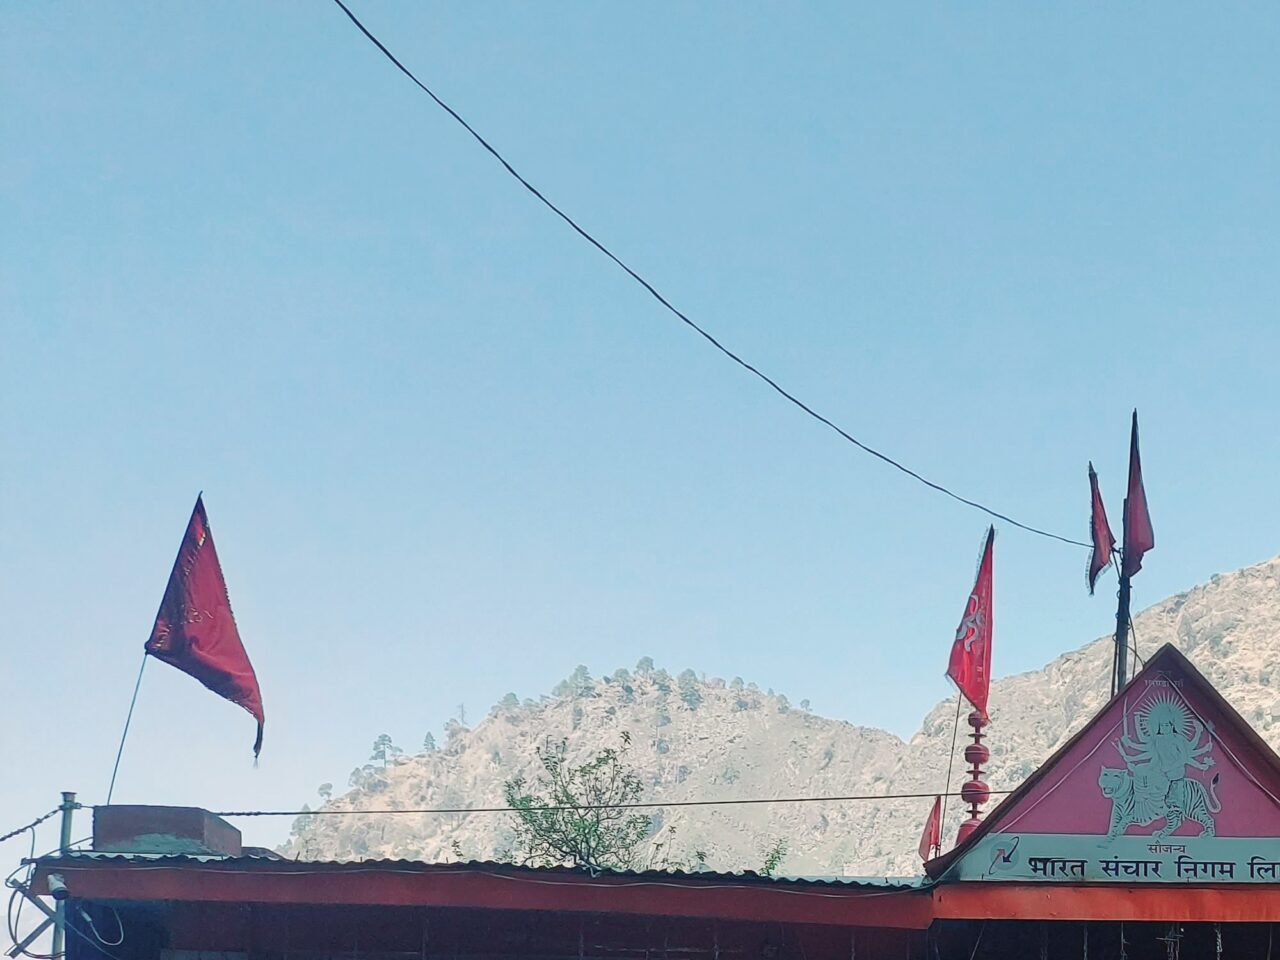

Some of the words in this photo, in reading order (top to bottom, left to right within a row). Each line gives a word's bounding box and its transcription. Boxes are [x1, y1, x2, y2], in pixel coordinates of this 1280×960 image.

[1028, 856, 1088, 878] भारत
[1098, 855, 1163, 878] संचार
[1173, 855, 1236, 878] निगम
